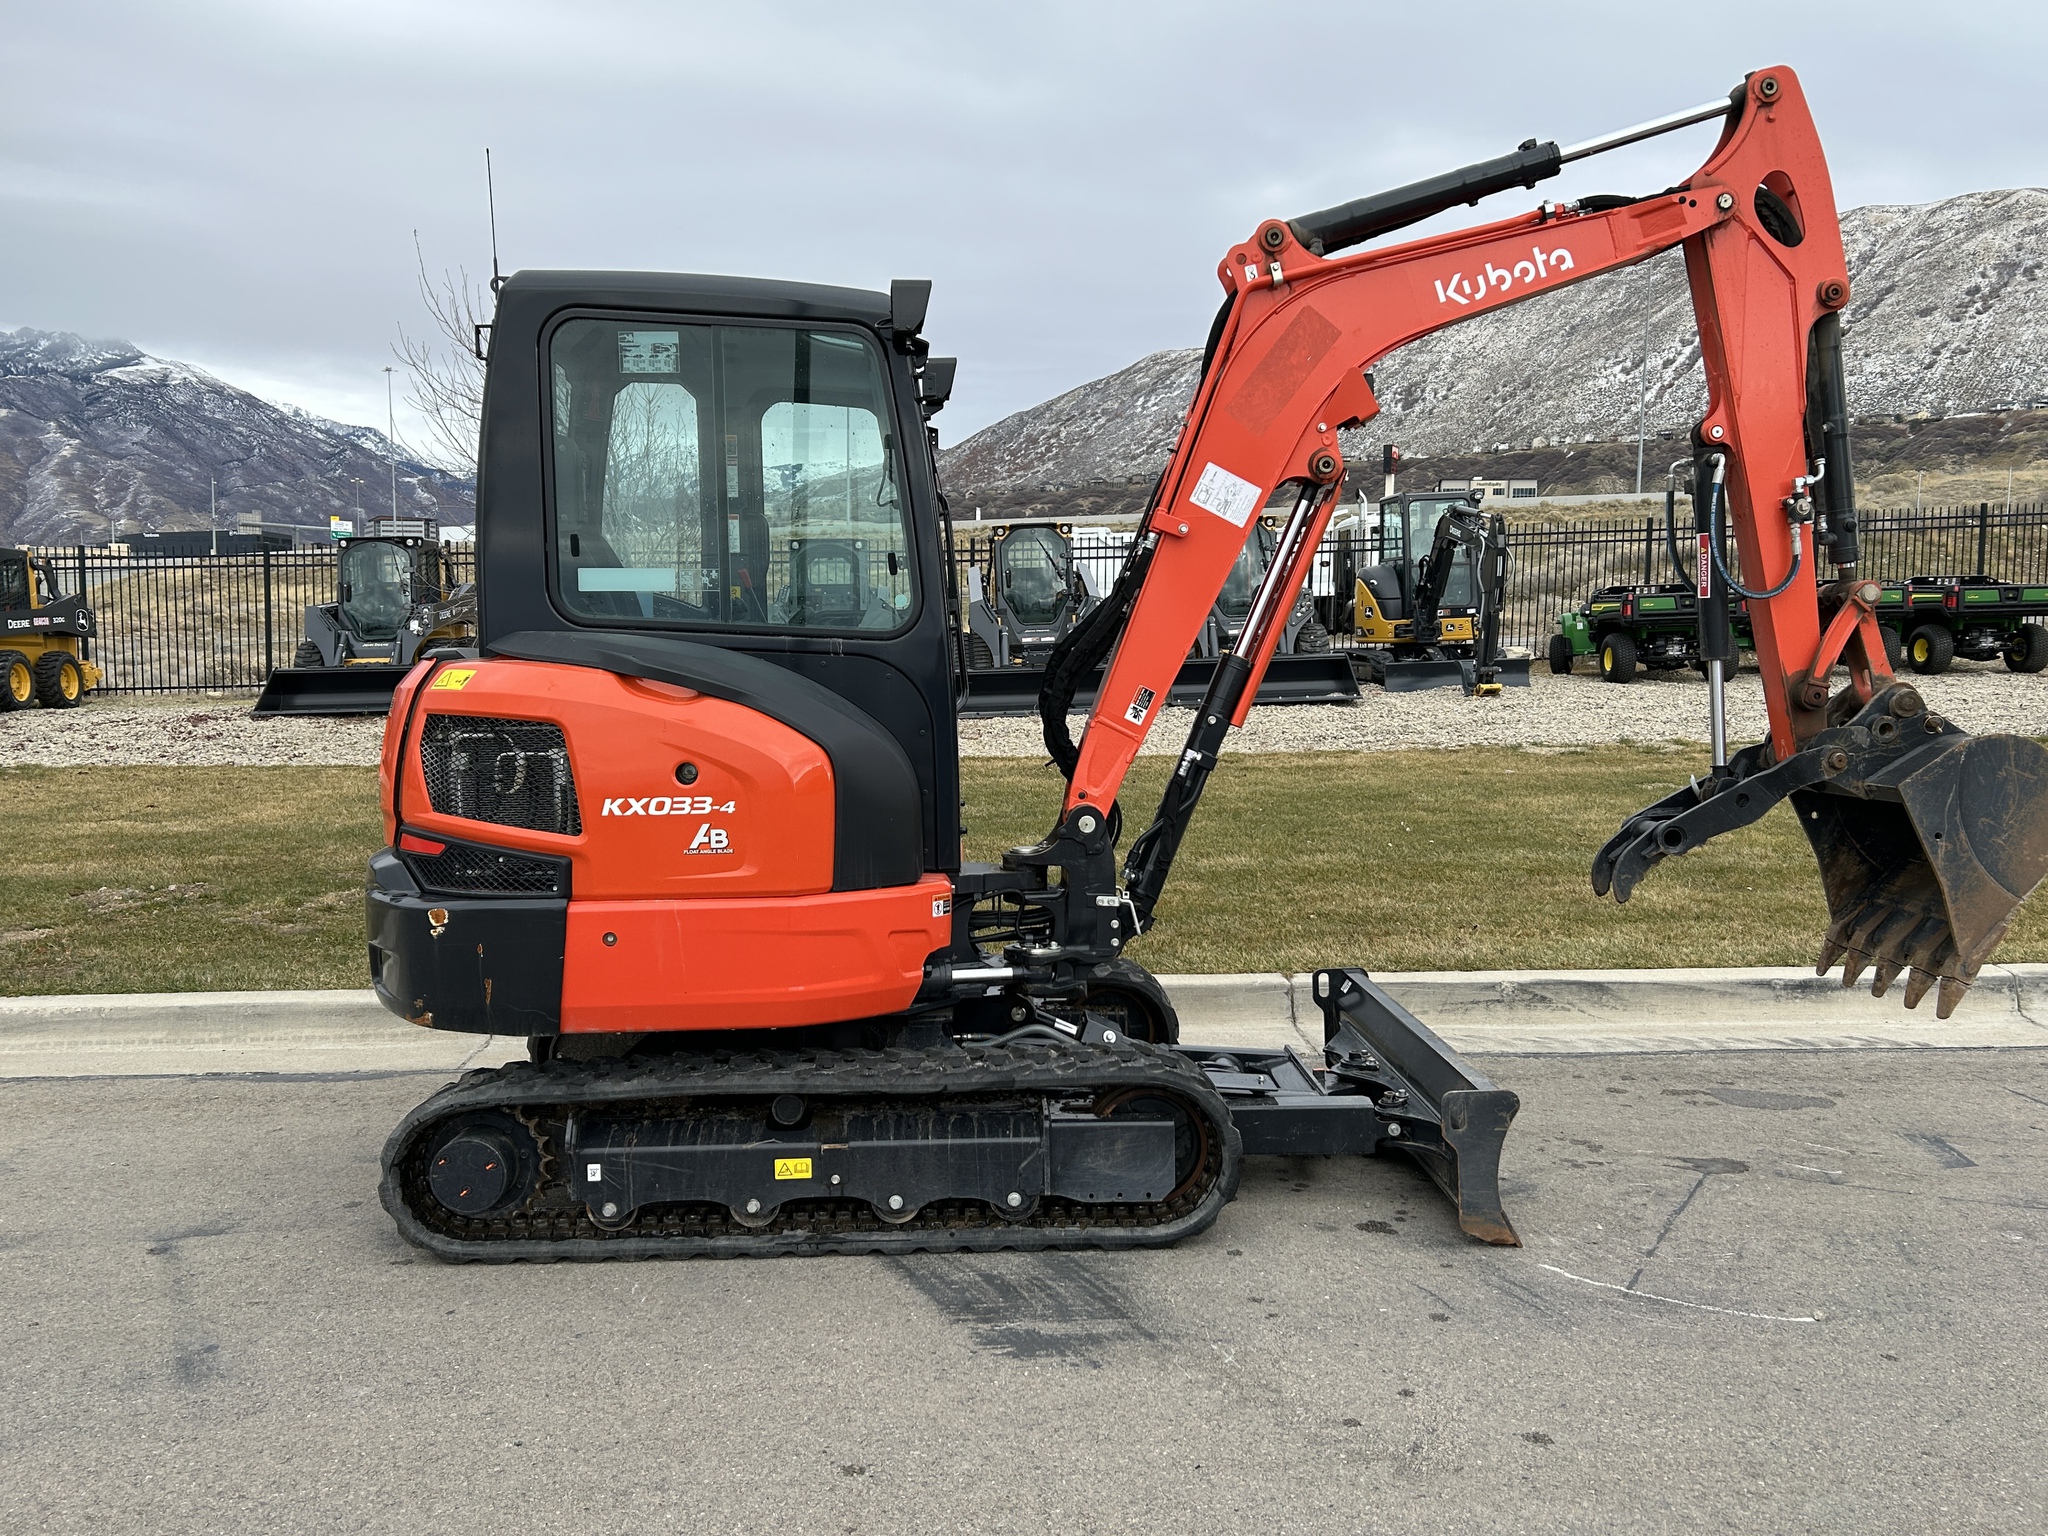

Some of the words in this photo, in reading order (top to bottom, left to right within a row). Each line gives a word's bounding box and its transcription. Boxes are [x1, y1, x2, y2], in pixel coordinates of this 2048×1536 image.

[1433, 246, 1575, 305] Kubota
[1700, 553, 1708, 588] DANGER
[7, 619, 31, 630] DEERE
[601, 796, 736, 817] KX033-4
